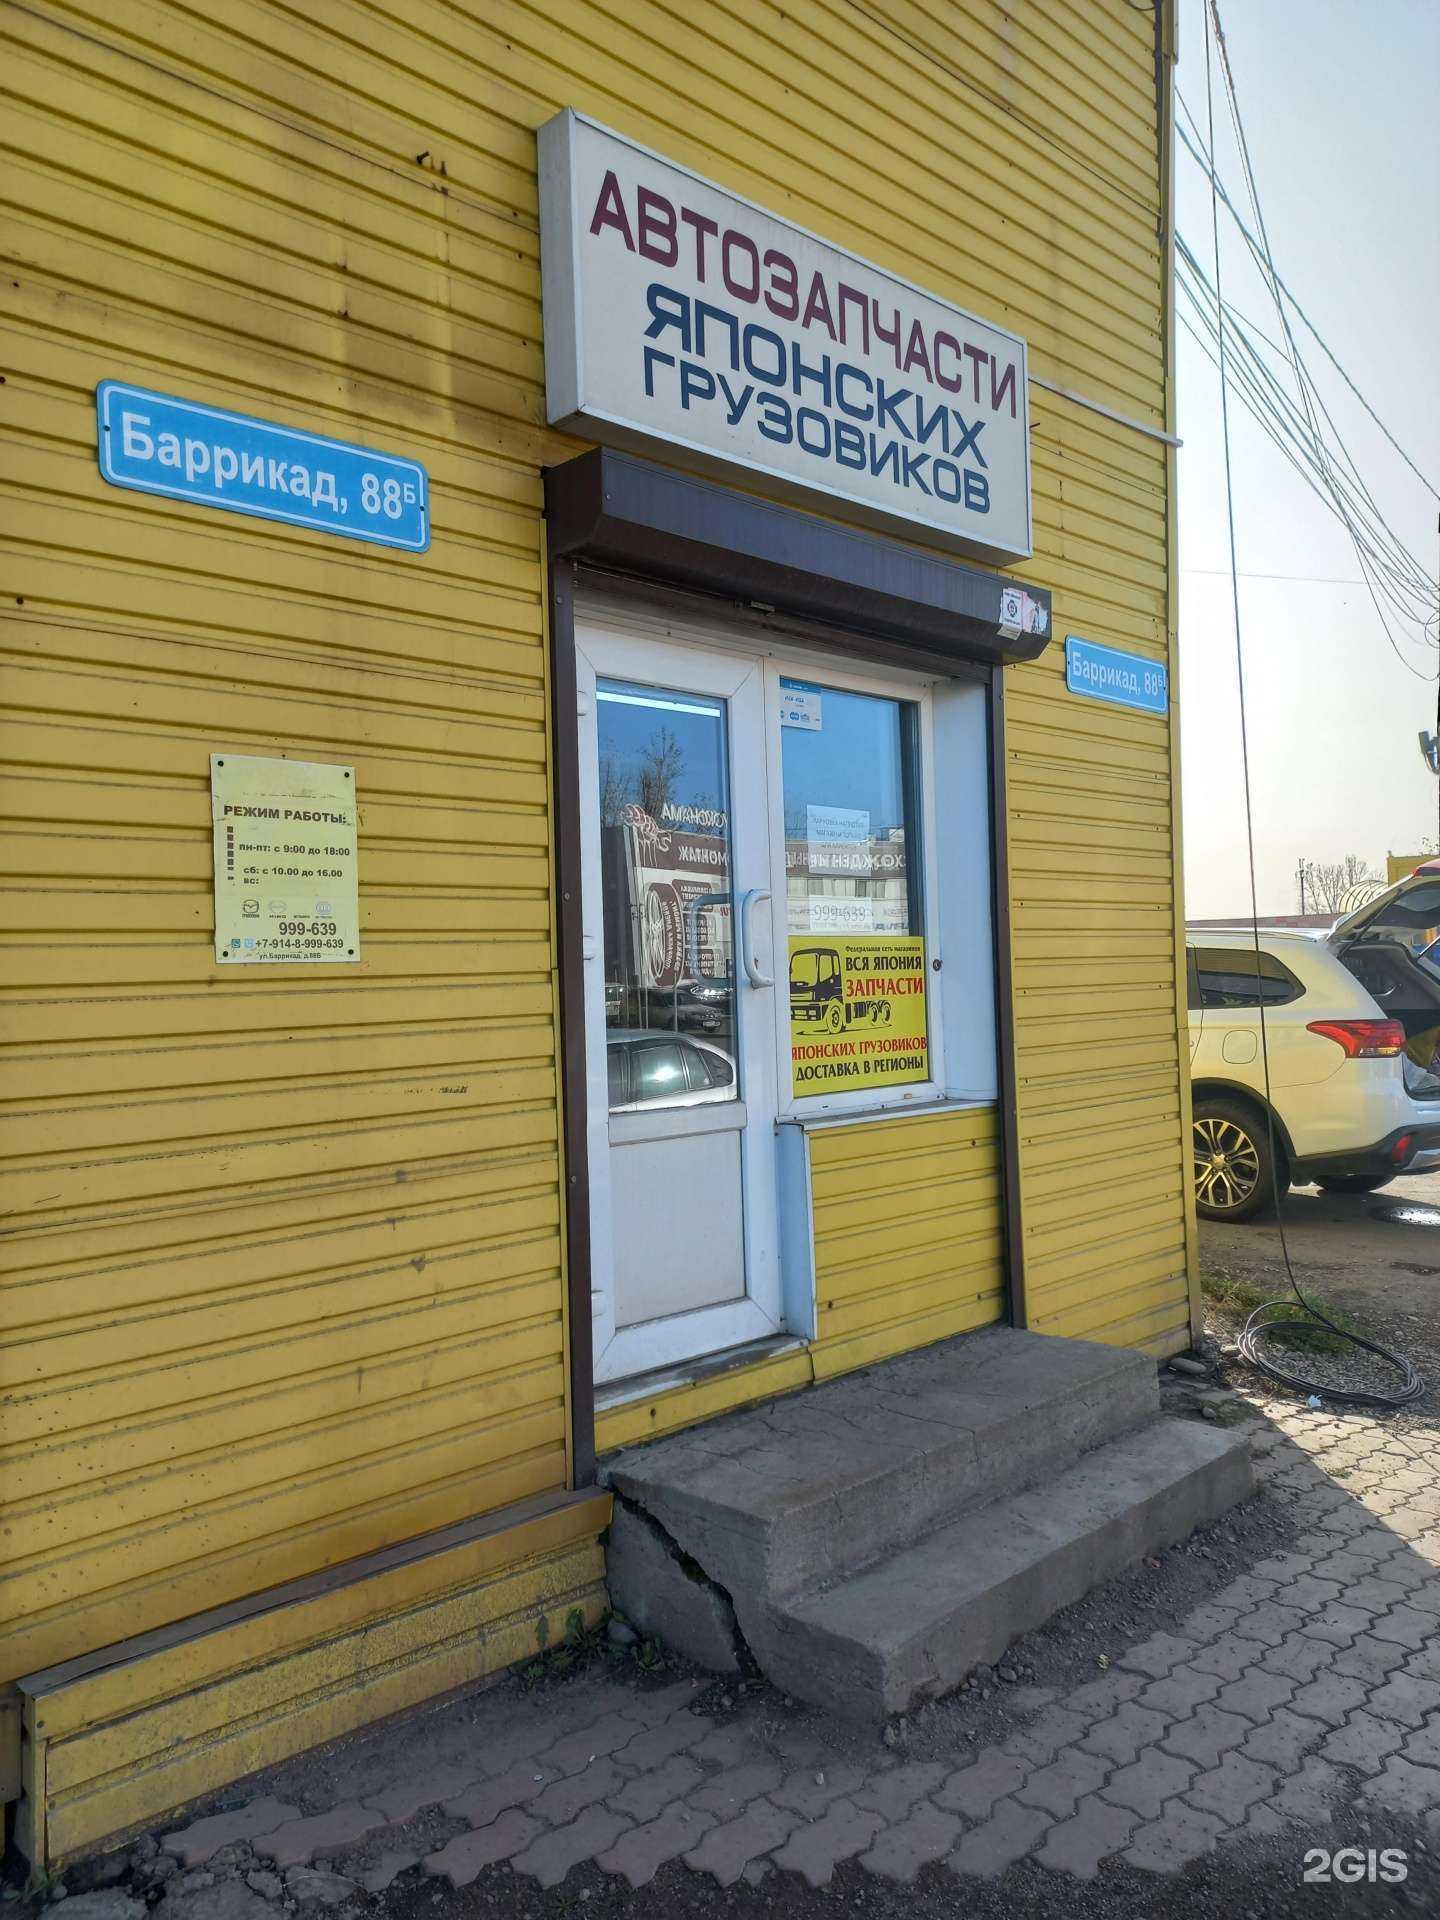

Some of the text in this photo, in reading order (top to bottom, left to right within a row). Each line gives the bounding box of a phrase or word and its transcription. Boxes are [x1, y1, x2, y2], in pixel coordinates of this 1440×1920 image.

[589, 169, 1017, 419] АВТОЗАПЧАСТИ
[643, 283, 988, 469] ЯПОНСКИХ
[643, 345, 991, 514] ГРУЗОВИКОВ
[121, 411, 348, 514] Баррикад,
[1072, 651, 1140, 695] Баррикад,
[223, 805, 347, 824] РЕЖИМ РАБОТЫ:
[239, 843, 350, 856] пн-пт: с 9:00 до 18:00
[243, 866, 259, 875] сб:
[272, 867, 299, 876] 10.00
[301, 869, 313, 878] до
[317, 868, 343, 878] 16.00
[279, 921, 337, 936] 999-639
[255, 938, 344, 949] +7-914-8-999-639
[845, 956, 922, 971] ВСЯ ЯПОНИЯ
[846, 977, 924, 997] ЗАПЧАСТИ
[791, 1037, 927, 1061] ЯПОНСКИХ ГРУЗОВИКОВ
[796, 1056, 924, 1081] ДОСТАВКА В РЕГИОНЫ
